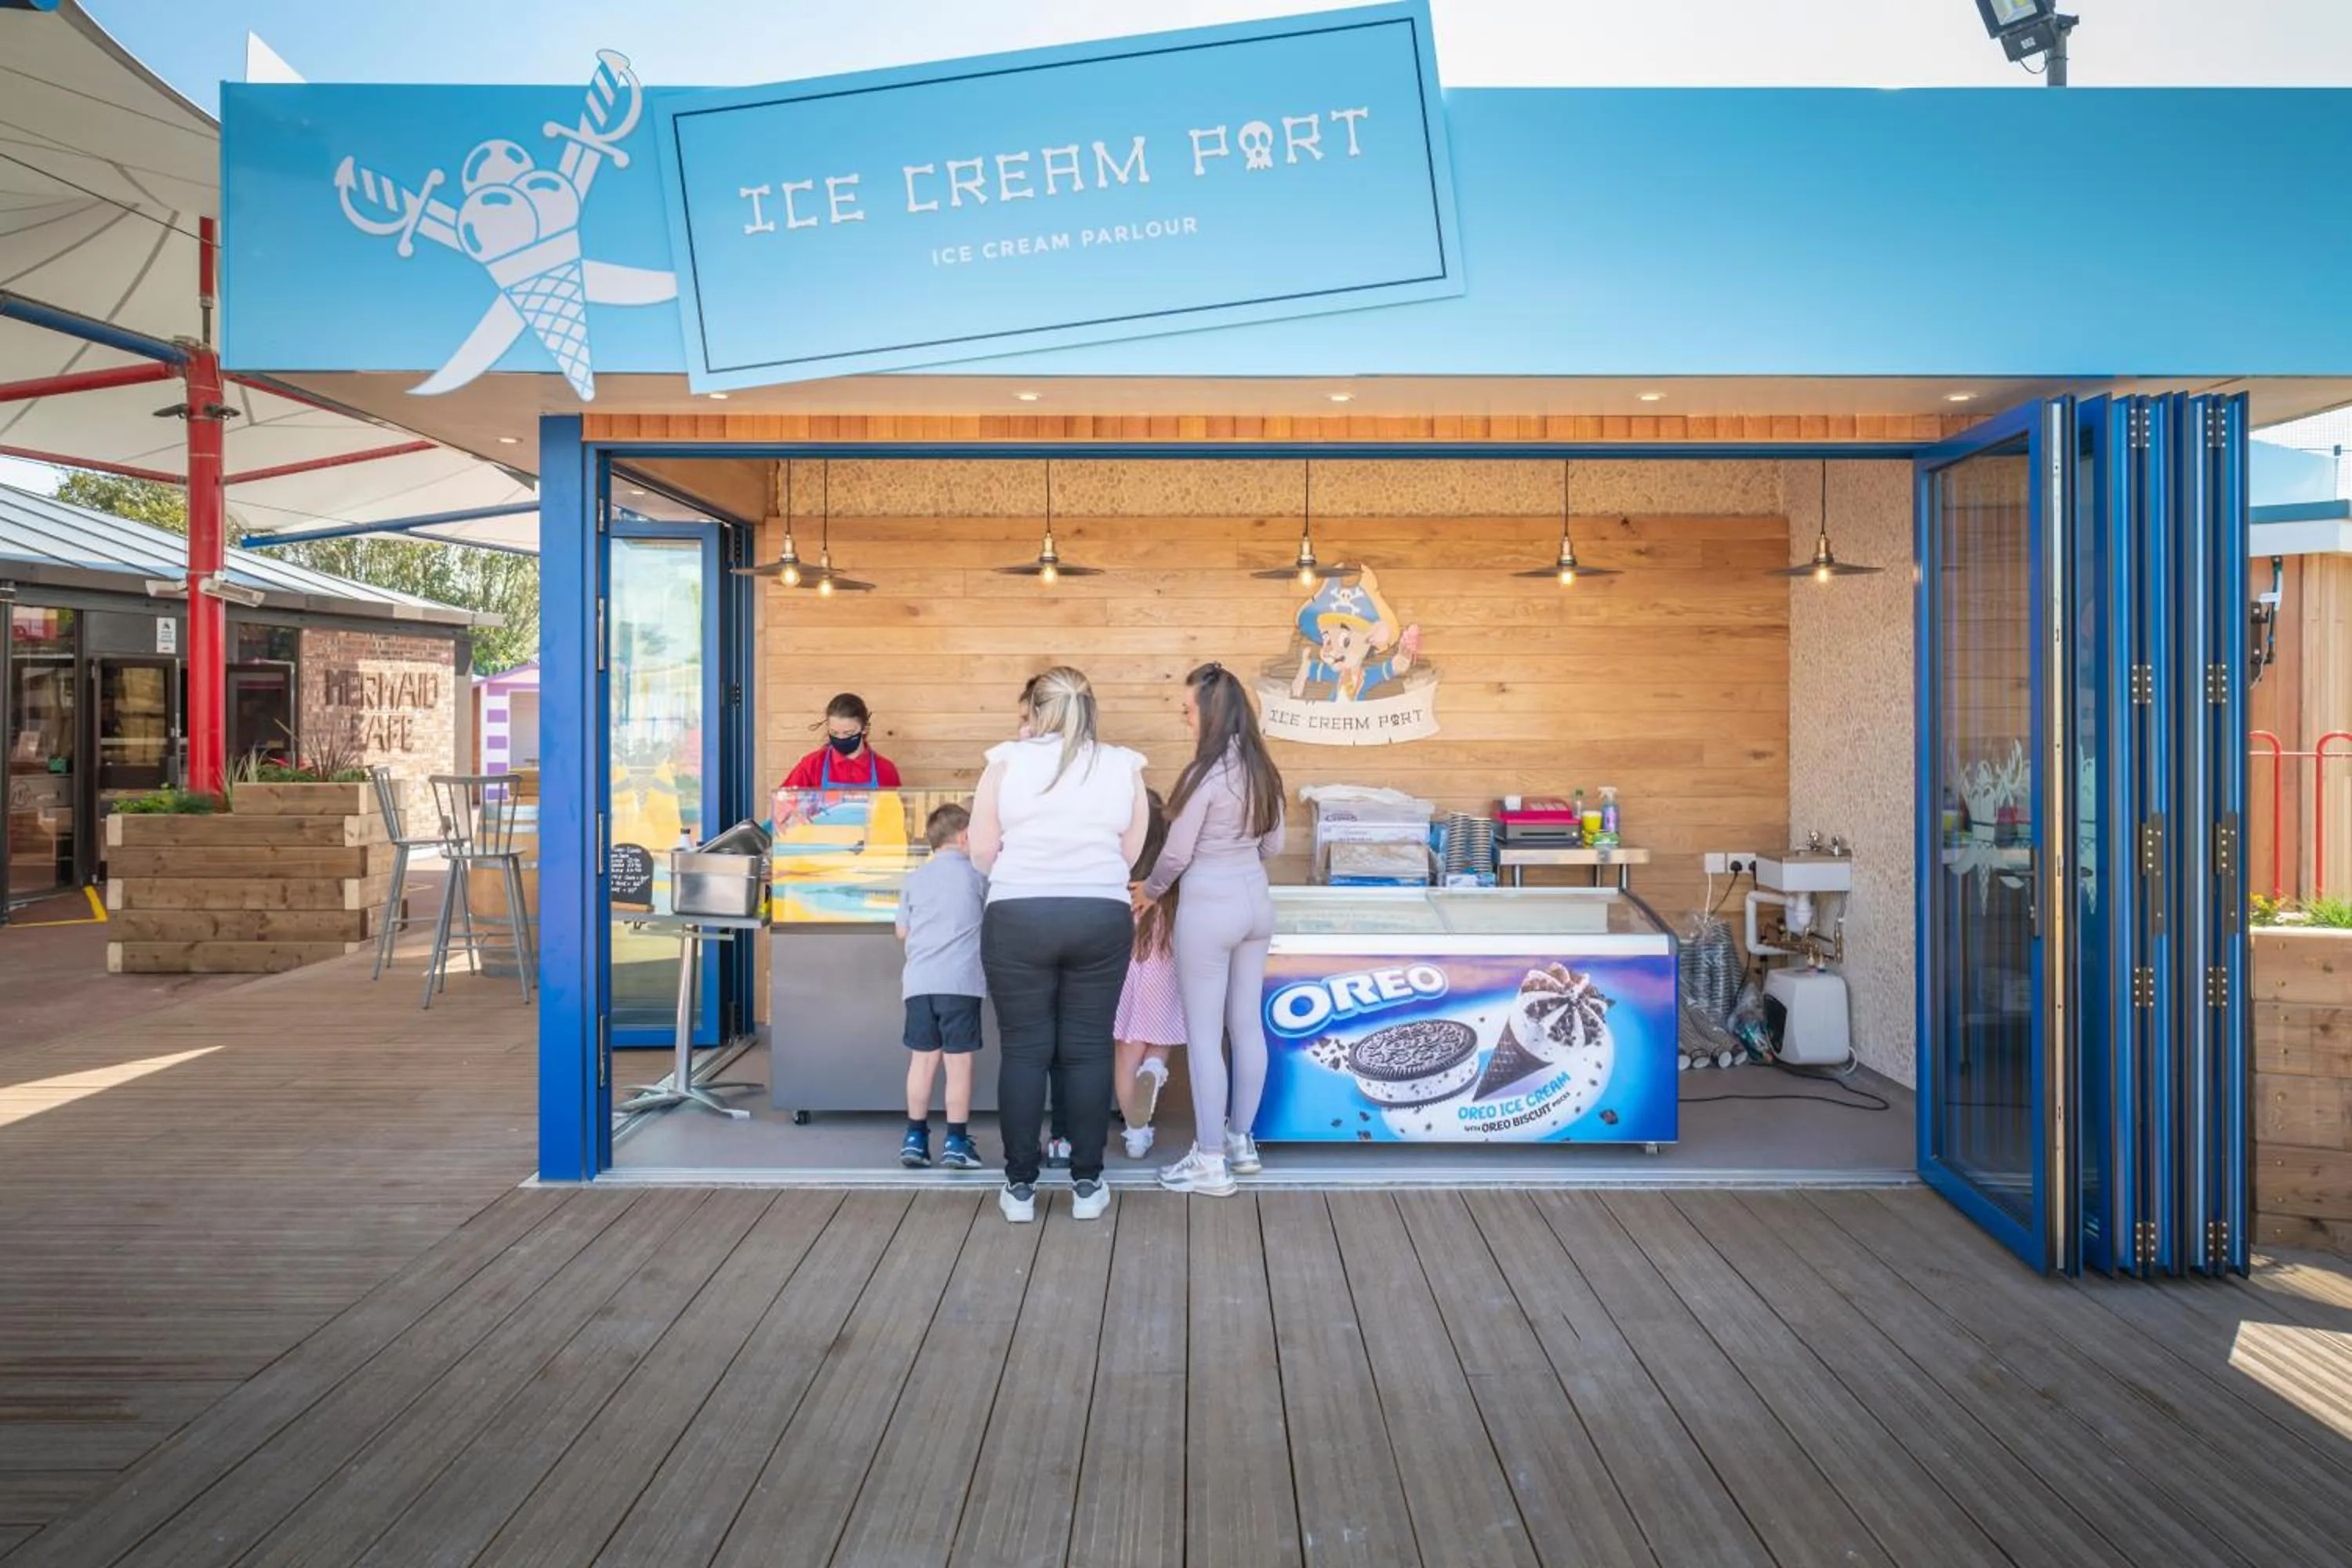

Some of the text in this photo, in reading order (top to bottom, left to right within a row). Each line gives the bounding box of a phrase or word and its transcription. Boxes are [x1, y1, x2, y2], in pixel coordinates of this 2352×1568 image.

[739, 107, 1368, 234] ICE CREAM PORT
[932, 216, 1199, 267] ICE CREAM PARLOUR
[325, 670, 439, 710] MERMAID
[350, 714, 413, 753] CAFE
[1268, 709, 1300, 726] ICE
[1308, 716, 1370, 730] CREAM
[1269, 964, 1446, 1033] OREO
[1458, 1071, 1571, 1120] OREO ICE CREAM
[1482, 1120, 1511, 1134] OREO
[1512, 1101, 1552, 1127] BISCUIT
